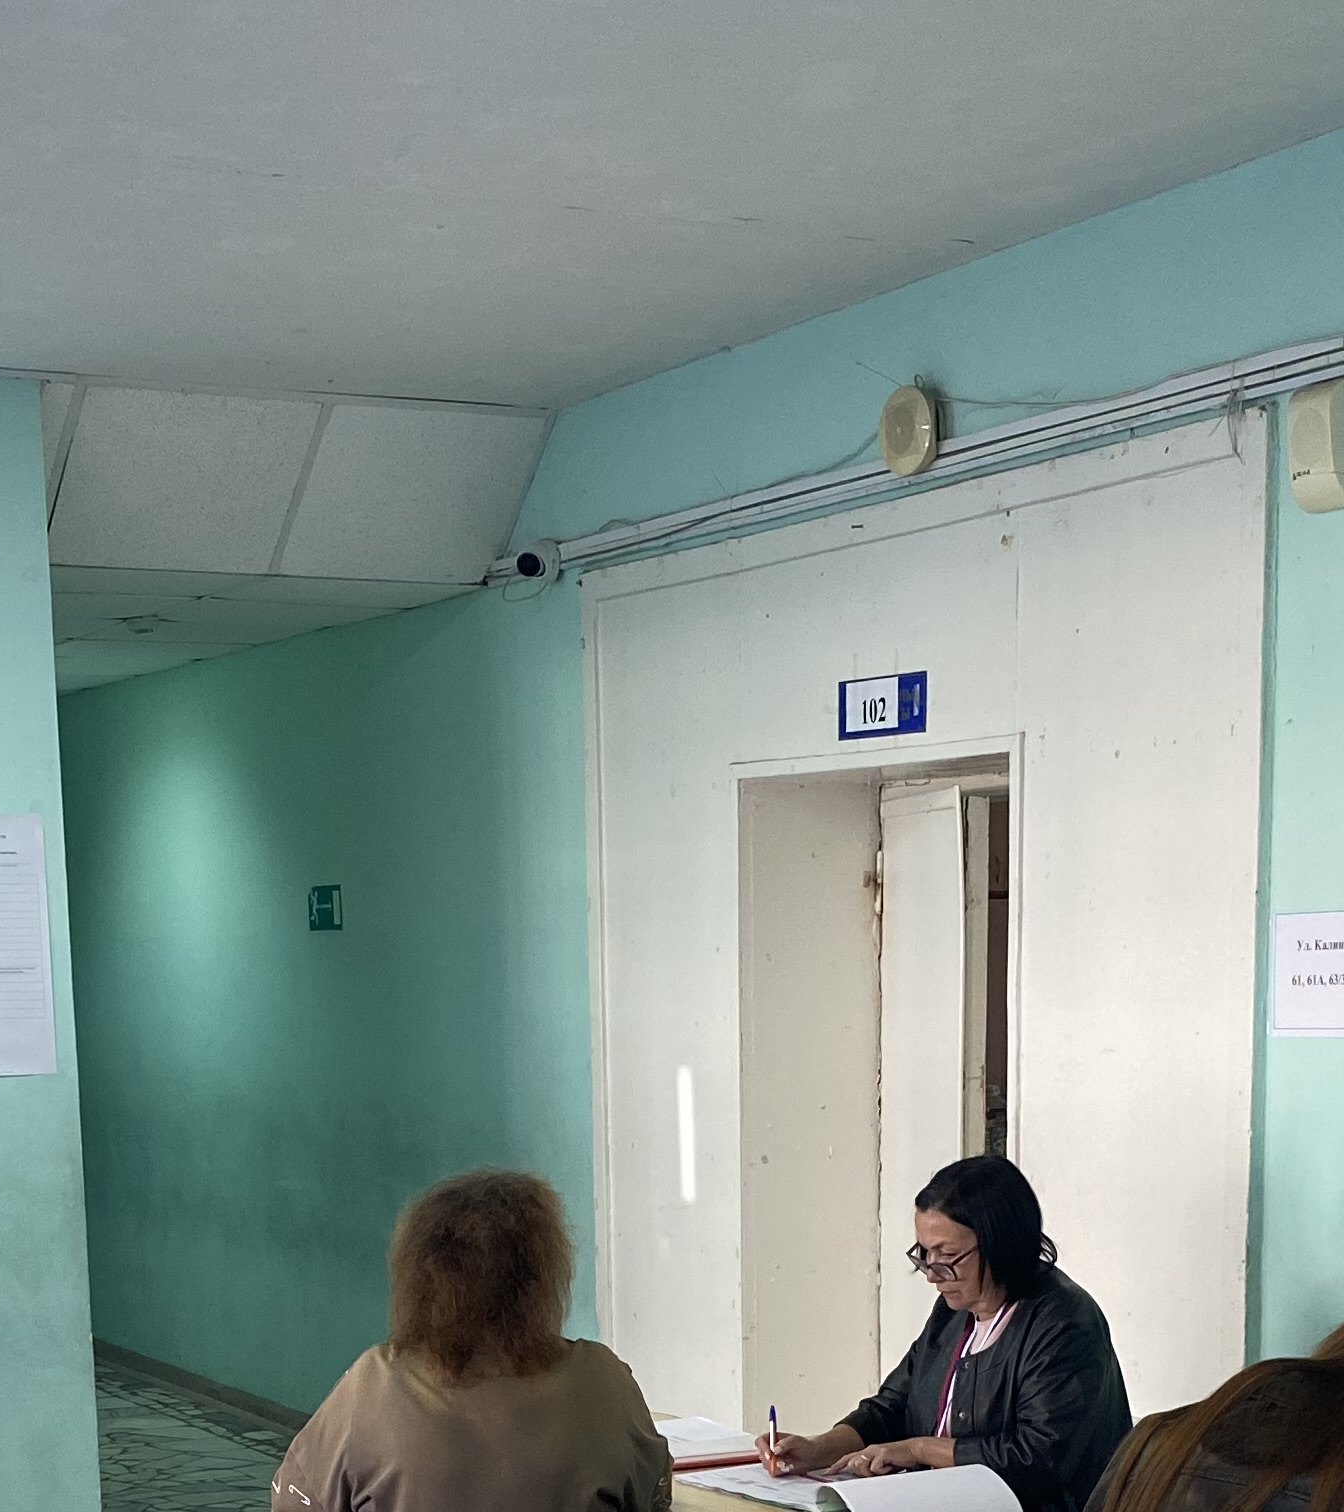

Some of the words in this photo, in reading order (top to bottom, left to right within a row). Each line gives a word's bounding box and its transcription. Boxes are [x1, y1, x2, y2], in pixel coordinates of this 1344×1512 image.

[862, 697, 886, 724] 102
[1297, 940, 1312, 951] Ул.
[1292, 975, 1305, 987] 61,
[1307, 975, 1327, 987] 61А,
